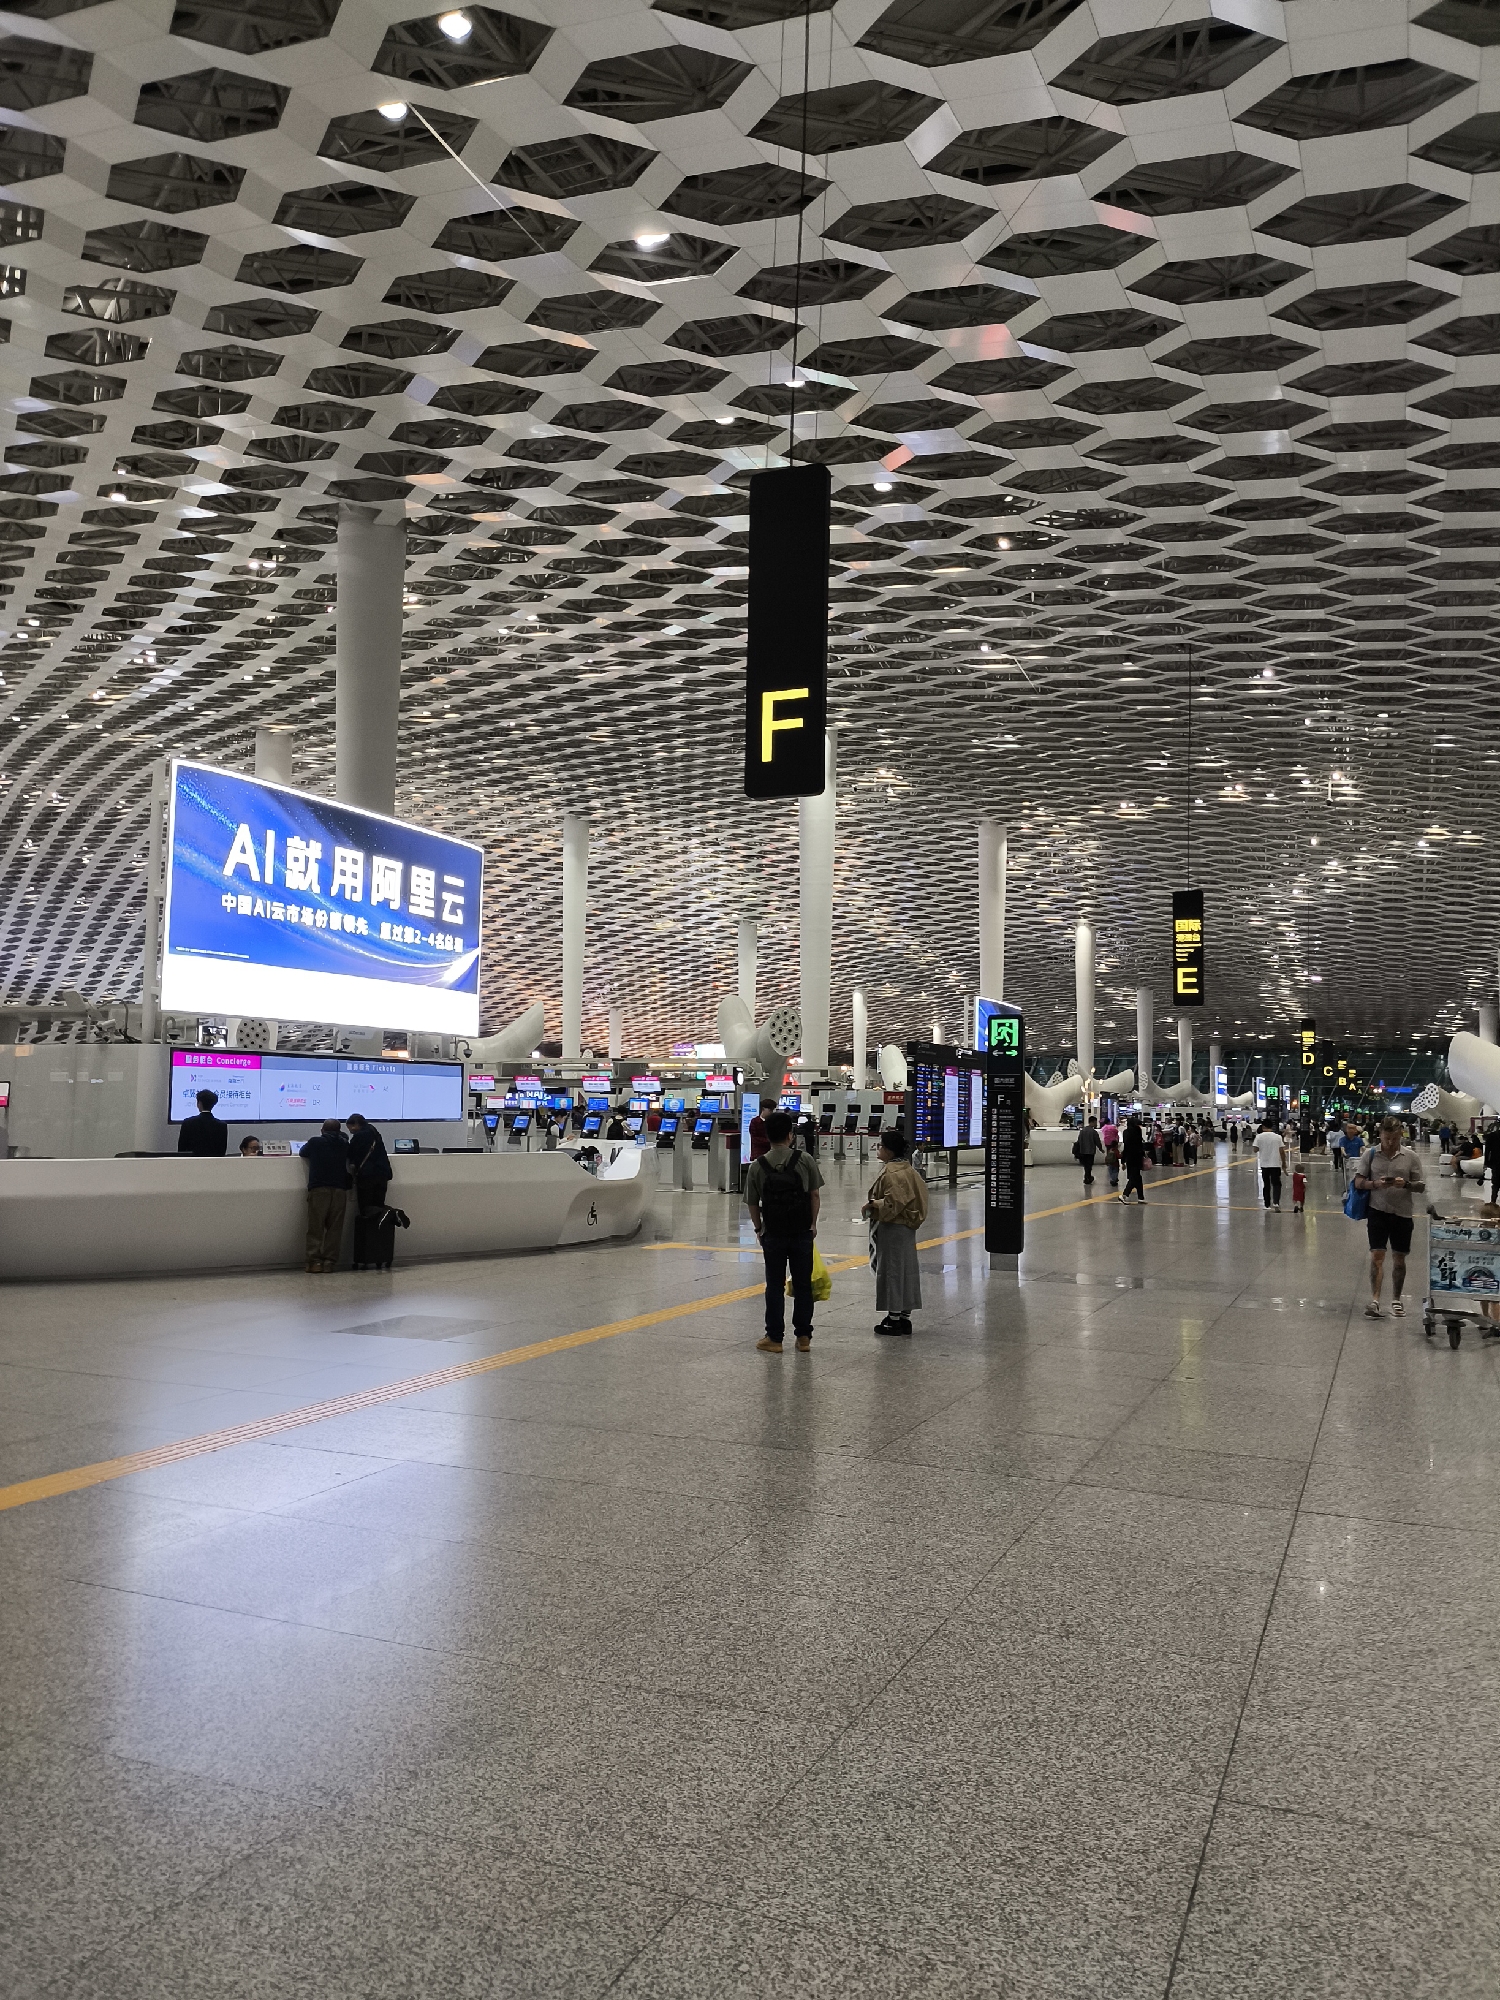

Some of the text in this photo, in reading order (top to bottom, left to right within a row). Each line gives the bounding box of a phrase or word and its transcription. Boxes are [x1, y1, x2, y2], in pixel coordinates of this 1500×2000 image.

[762, 687, 809, 763] F
[222, 823, 465, 925] AI就用阿里云
[1177, 967, 1199, 994] E
[216, 1057, 252, 1067] Concierge
[1303, 1053, 1314, 1064] D
[372, 1064, 396, 1073] Tickets
[1323, 1066, 1333, 1077] C
[1338, 1077, 1347, 1086] B
[997, 1094, 1005, 1105] F
